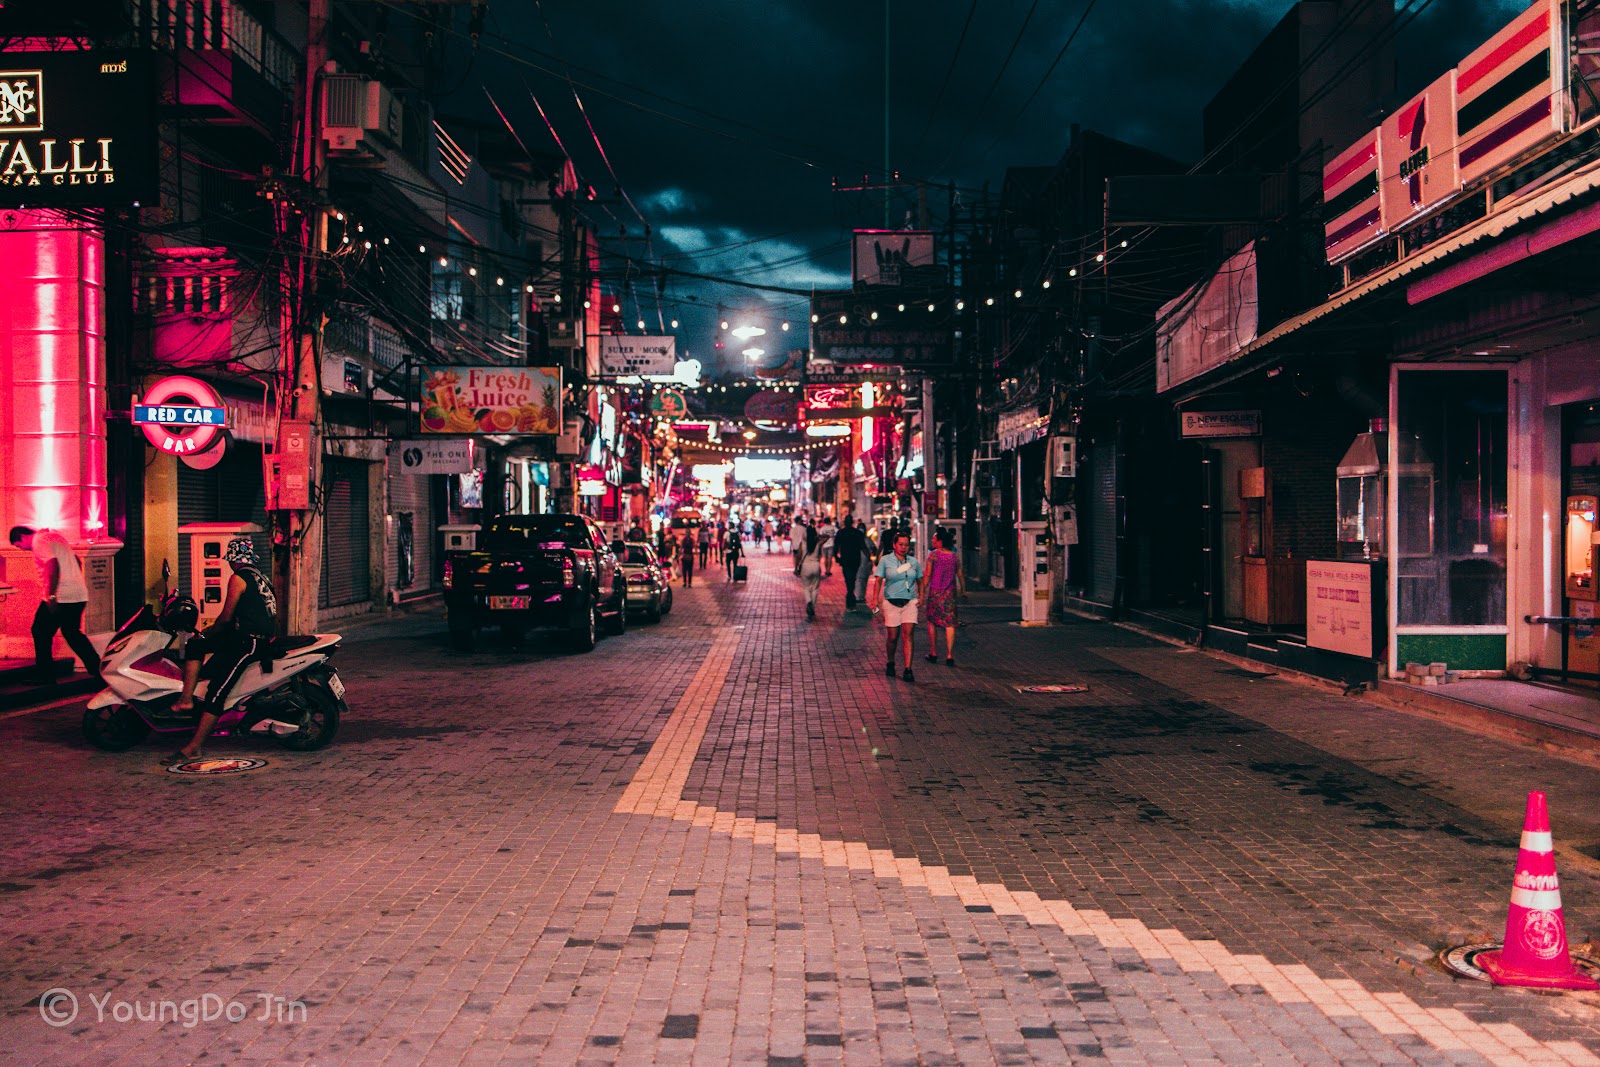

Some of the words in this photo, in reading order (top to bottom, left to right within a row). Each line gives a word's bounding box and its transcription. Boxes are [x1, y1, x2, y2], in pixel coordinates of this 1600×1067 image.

[1399, 146, 1429, 180] ELEVEN
[53, 172, 115, 185] CLUB
[608, 346, 634, 354] SUPER
[643, 346, 667, 354] MOD
[830, 347, 895, 359] SEAFOOD
[806, 363, 835, 375] SEA
[468, 369, 533, 392] Fresh
[467, 389, 528, 407] Juice
[148, 407, 177, 422] RED
[183, 408, 213, 423] CAR
[1197, 415, 1217, 423] NEW
[1220, 414, 1255, 423] ESQUIRE
[163, 436, 196, 452] BAR
